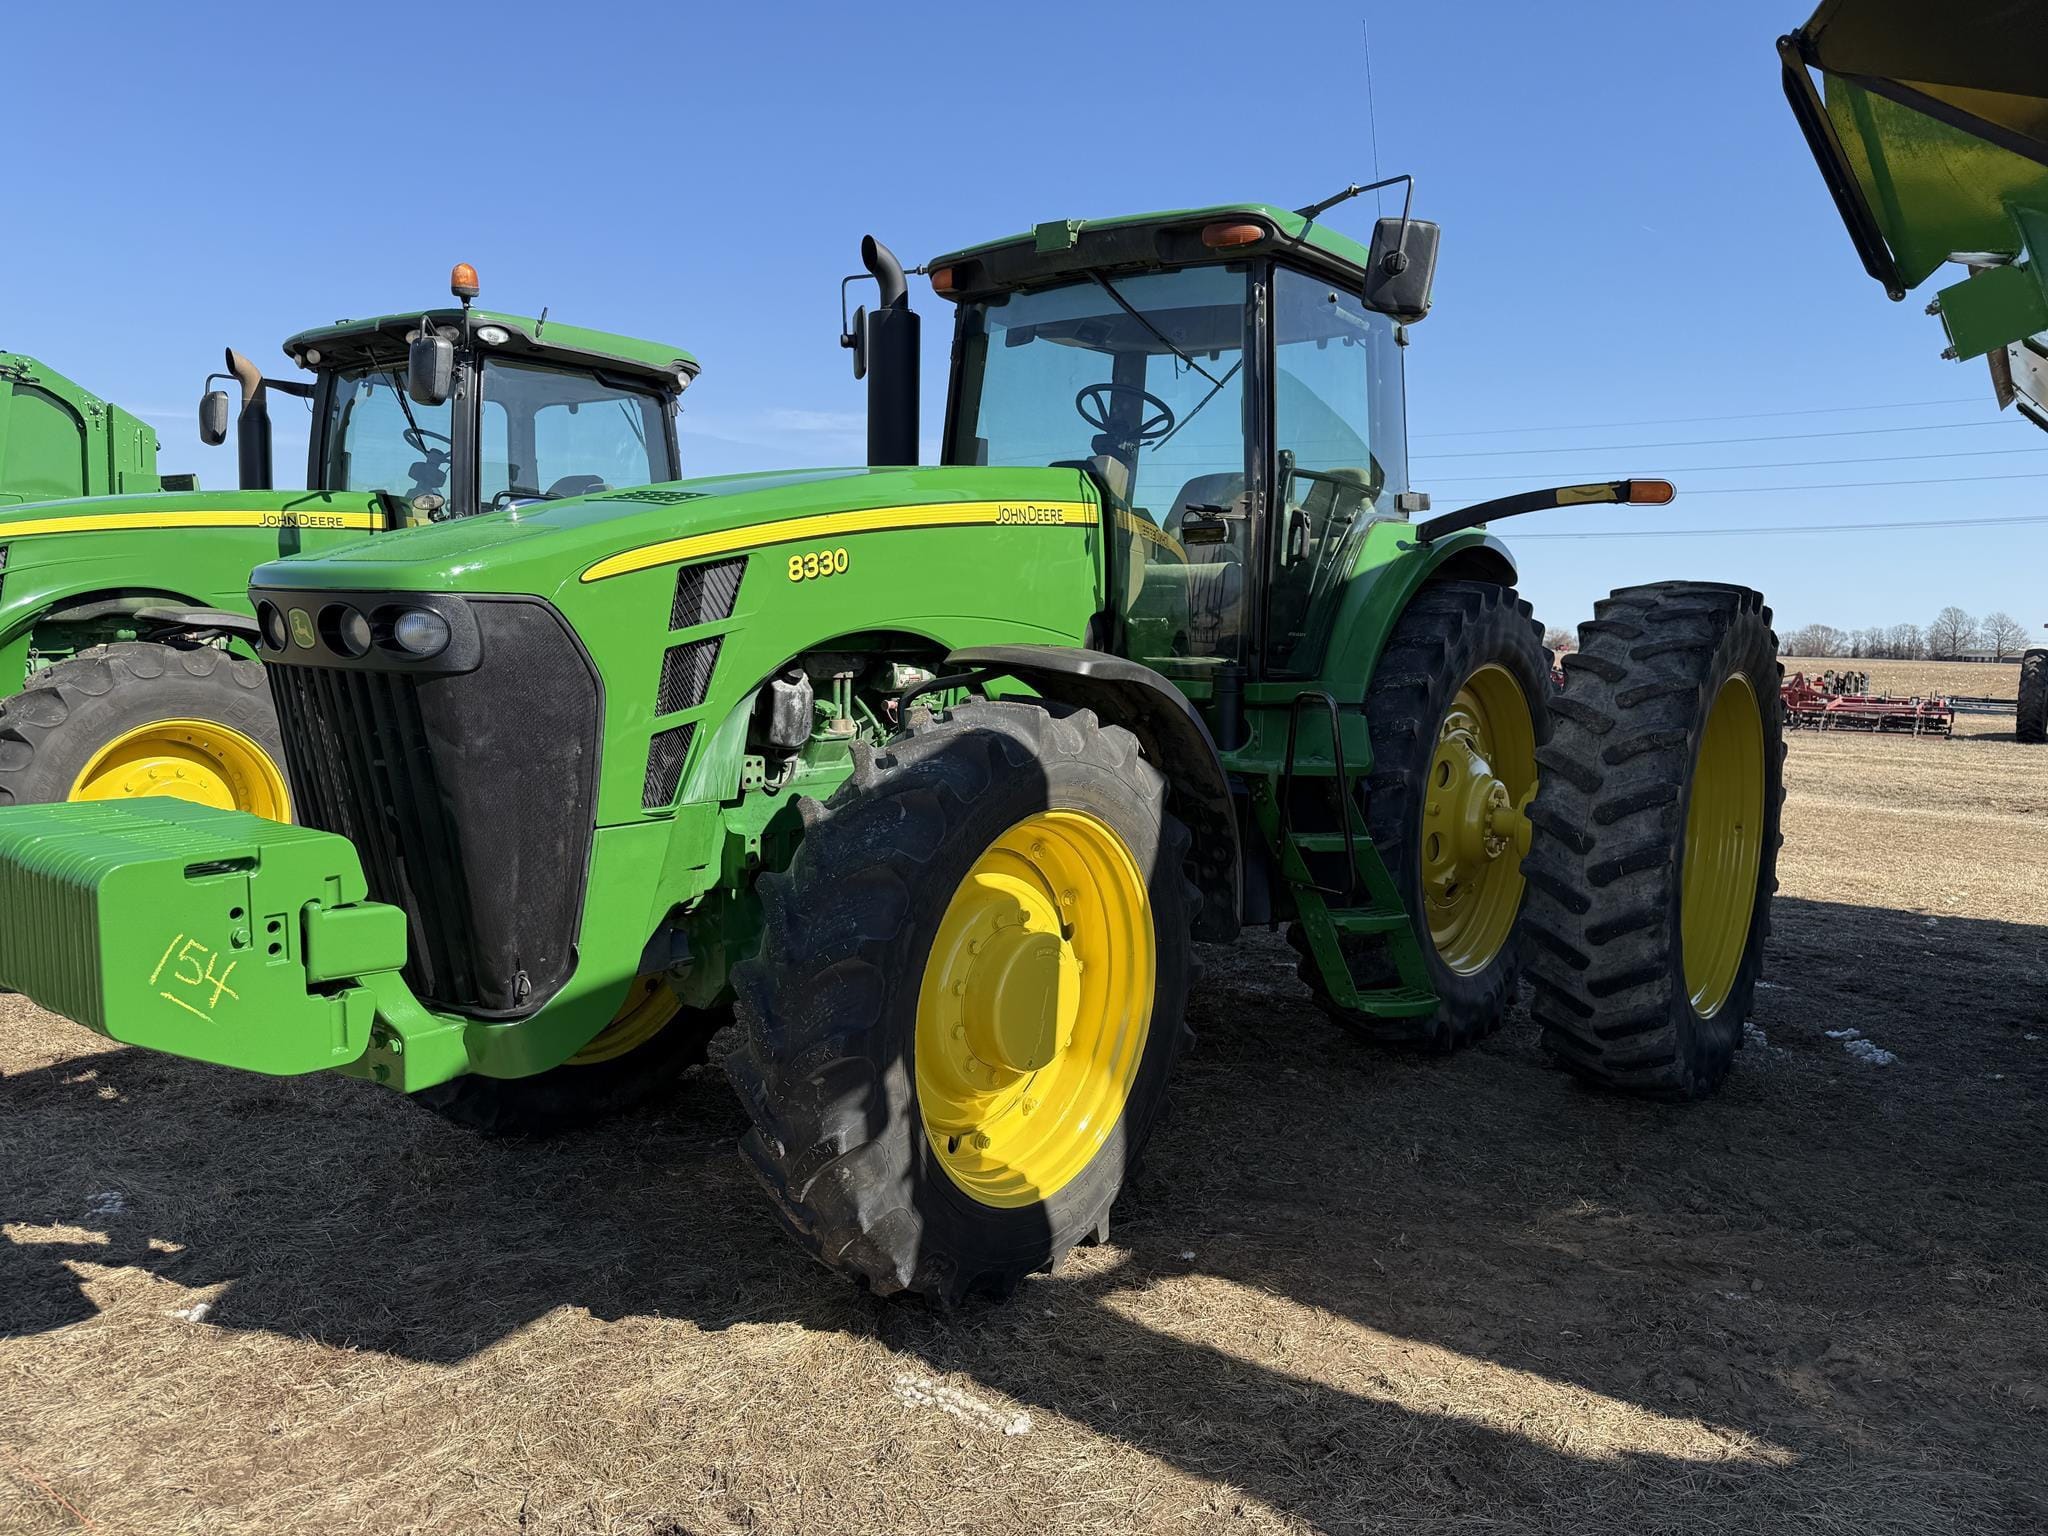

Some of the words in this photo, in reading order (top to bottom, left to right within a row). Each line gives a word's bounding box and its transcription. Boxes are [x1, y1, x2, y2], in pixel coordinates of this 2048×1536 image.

[259, 513, 298, 526] JOHN
[299, 514, 344, 527] DEERE
[996, 504, 1027, 522] JOHN
[1027, 505, 1064, 522] DEERE
[788, 547, 850, 583] 8330
[149, 933, 240, 1009] 154
